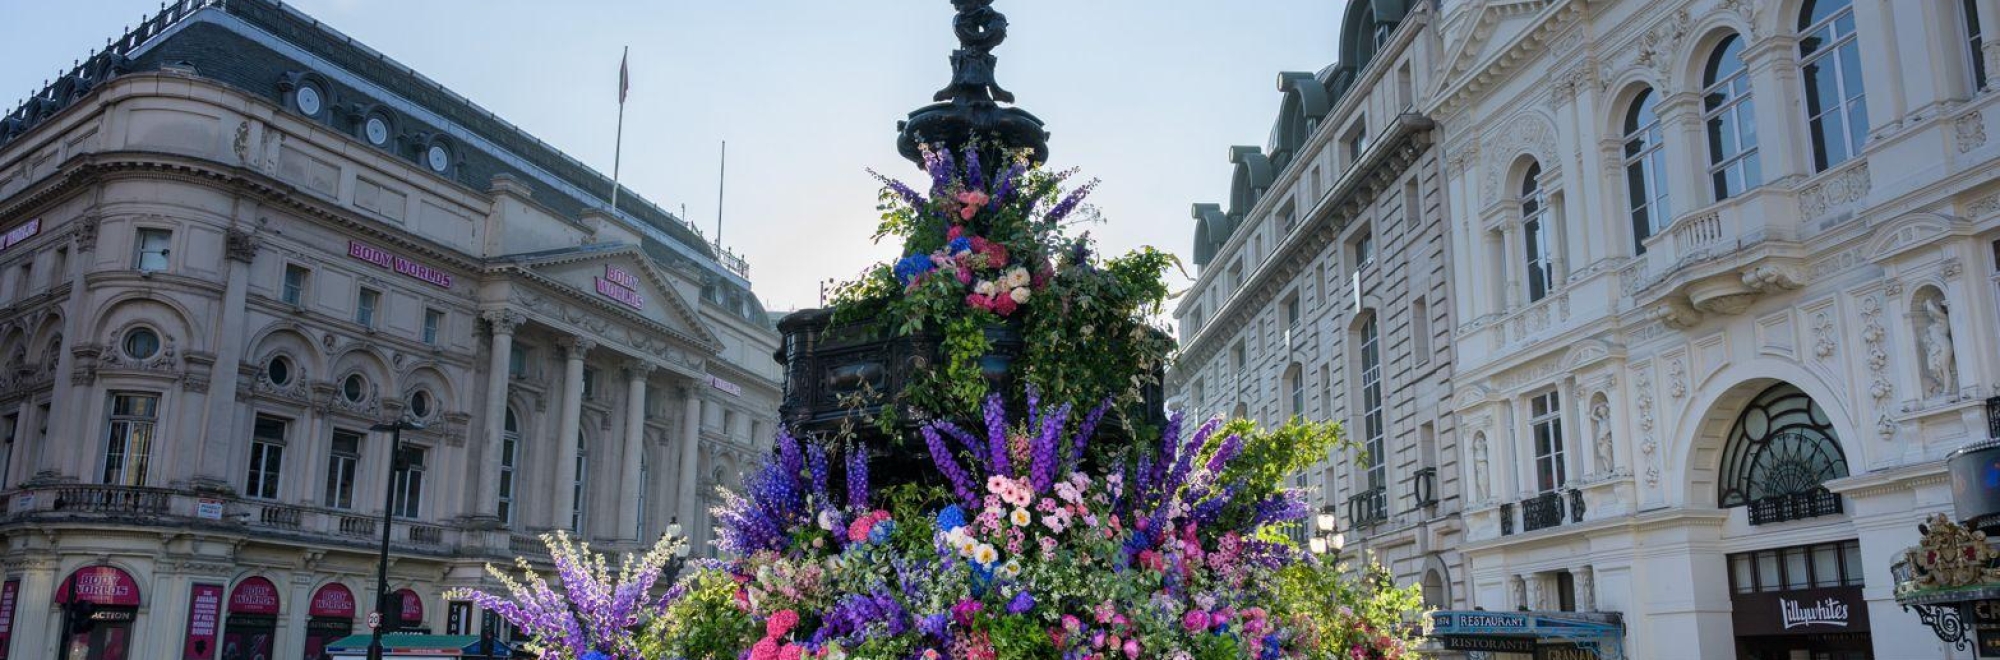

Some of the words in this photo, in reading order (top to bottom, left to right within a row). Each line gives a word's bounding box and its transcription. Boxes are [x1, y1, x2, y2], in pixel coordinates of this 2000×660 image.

[350, 241, 393, 268] BODY
[396, 256, 451, 288] WORLDS
[607, 265, 639, 291] BODY
[597, 277, 644, 310] WORLDS
[81, 573, 121, 586] BODY
[1461, 615, 1523, 627] RESTAURANT
[1780, 597, 1848, 629] Lillywhites
[1450, 637, 1534, 651] RISTORANTE
